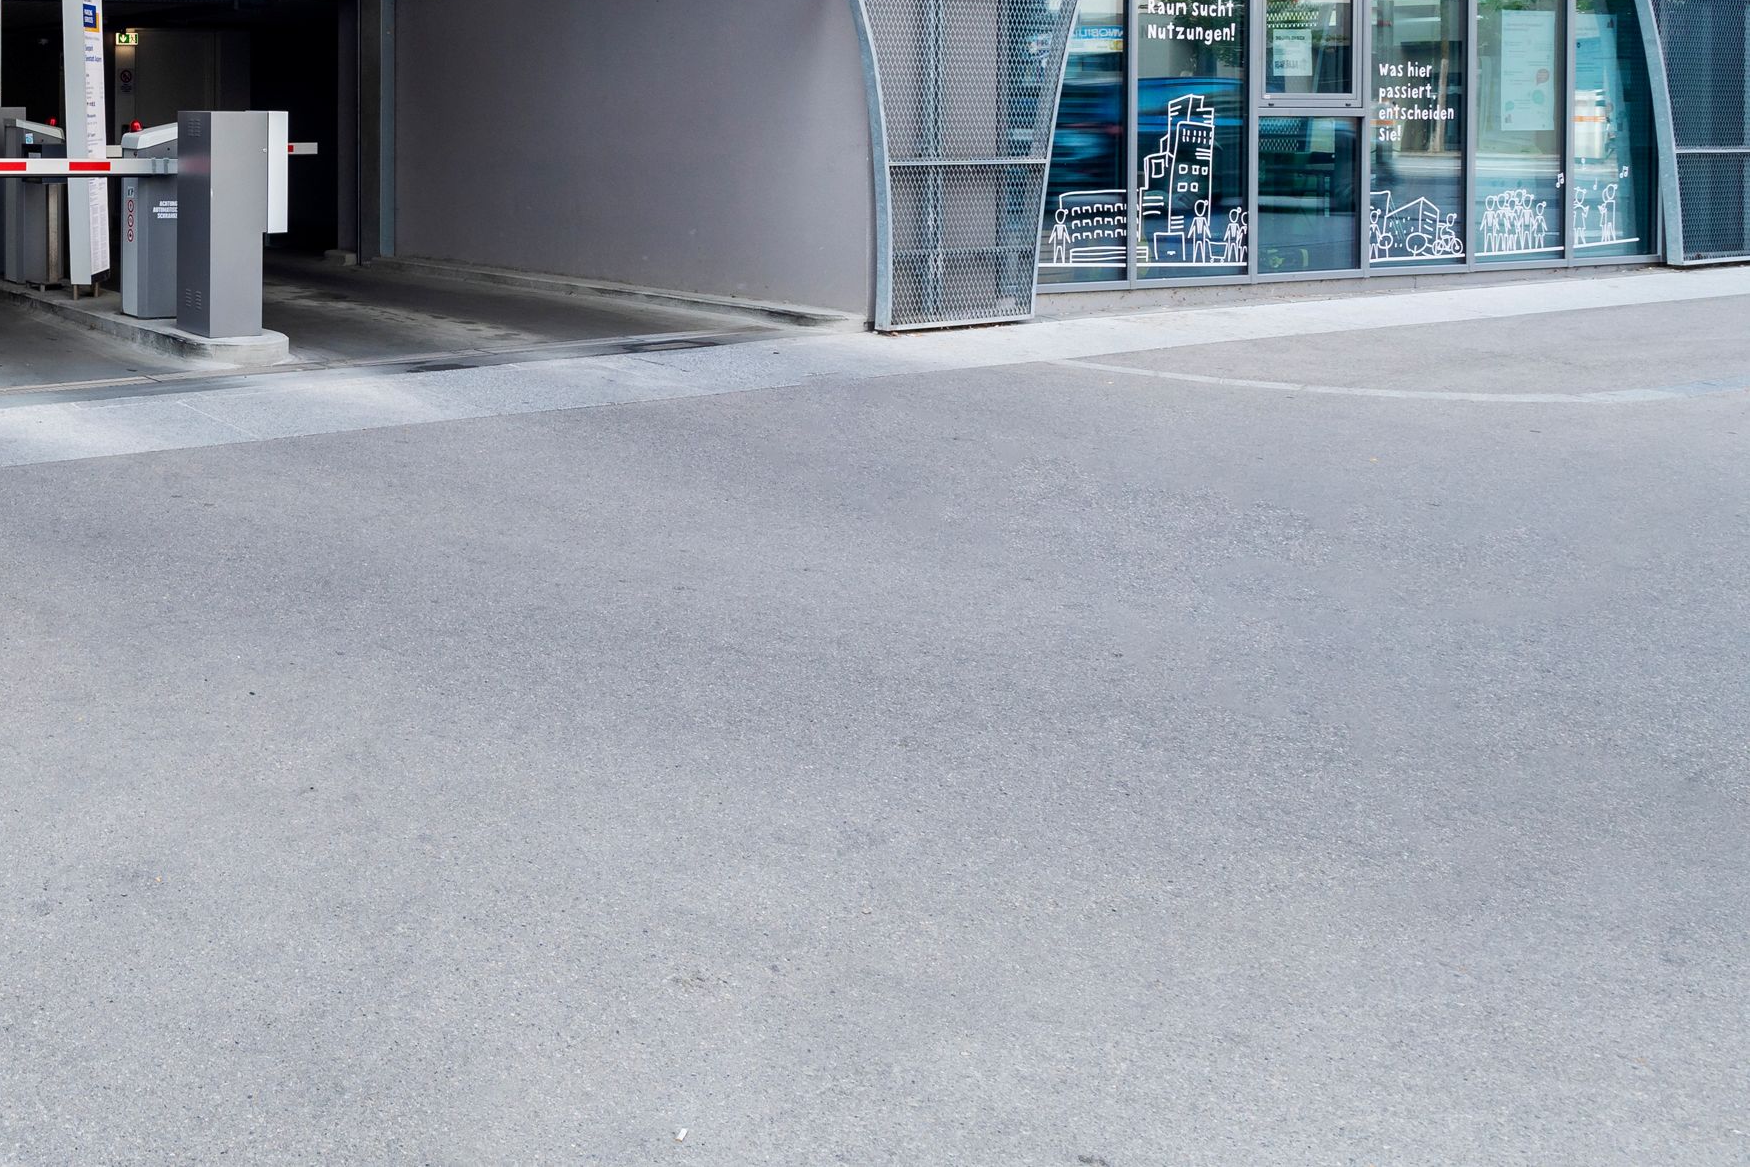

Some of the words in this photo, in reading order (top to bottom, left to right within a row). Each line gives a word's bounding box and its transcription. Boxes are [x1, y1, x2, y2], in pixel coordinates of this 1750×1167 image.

[1191, 0, 1234, 17] sucht
[1147, 21, 1236, 46] Nutzungen!
[1378, 63, 1404, 77] Was
[1407, 60, 1433, 78] hier
[1378, 82, 1437, 104] passiert,
[1378, 104, 1455, 121] entscheiden
